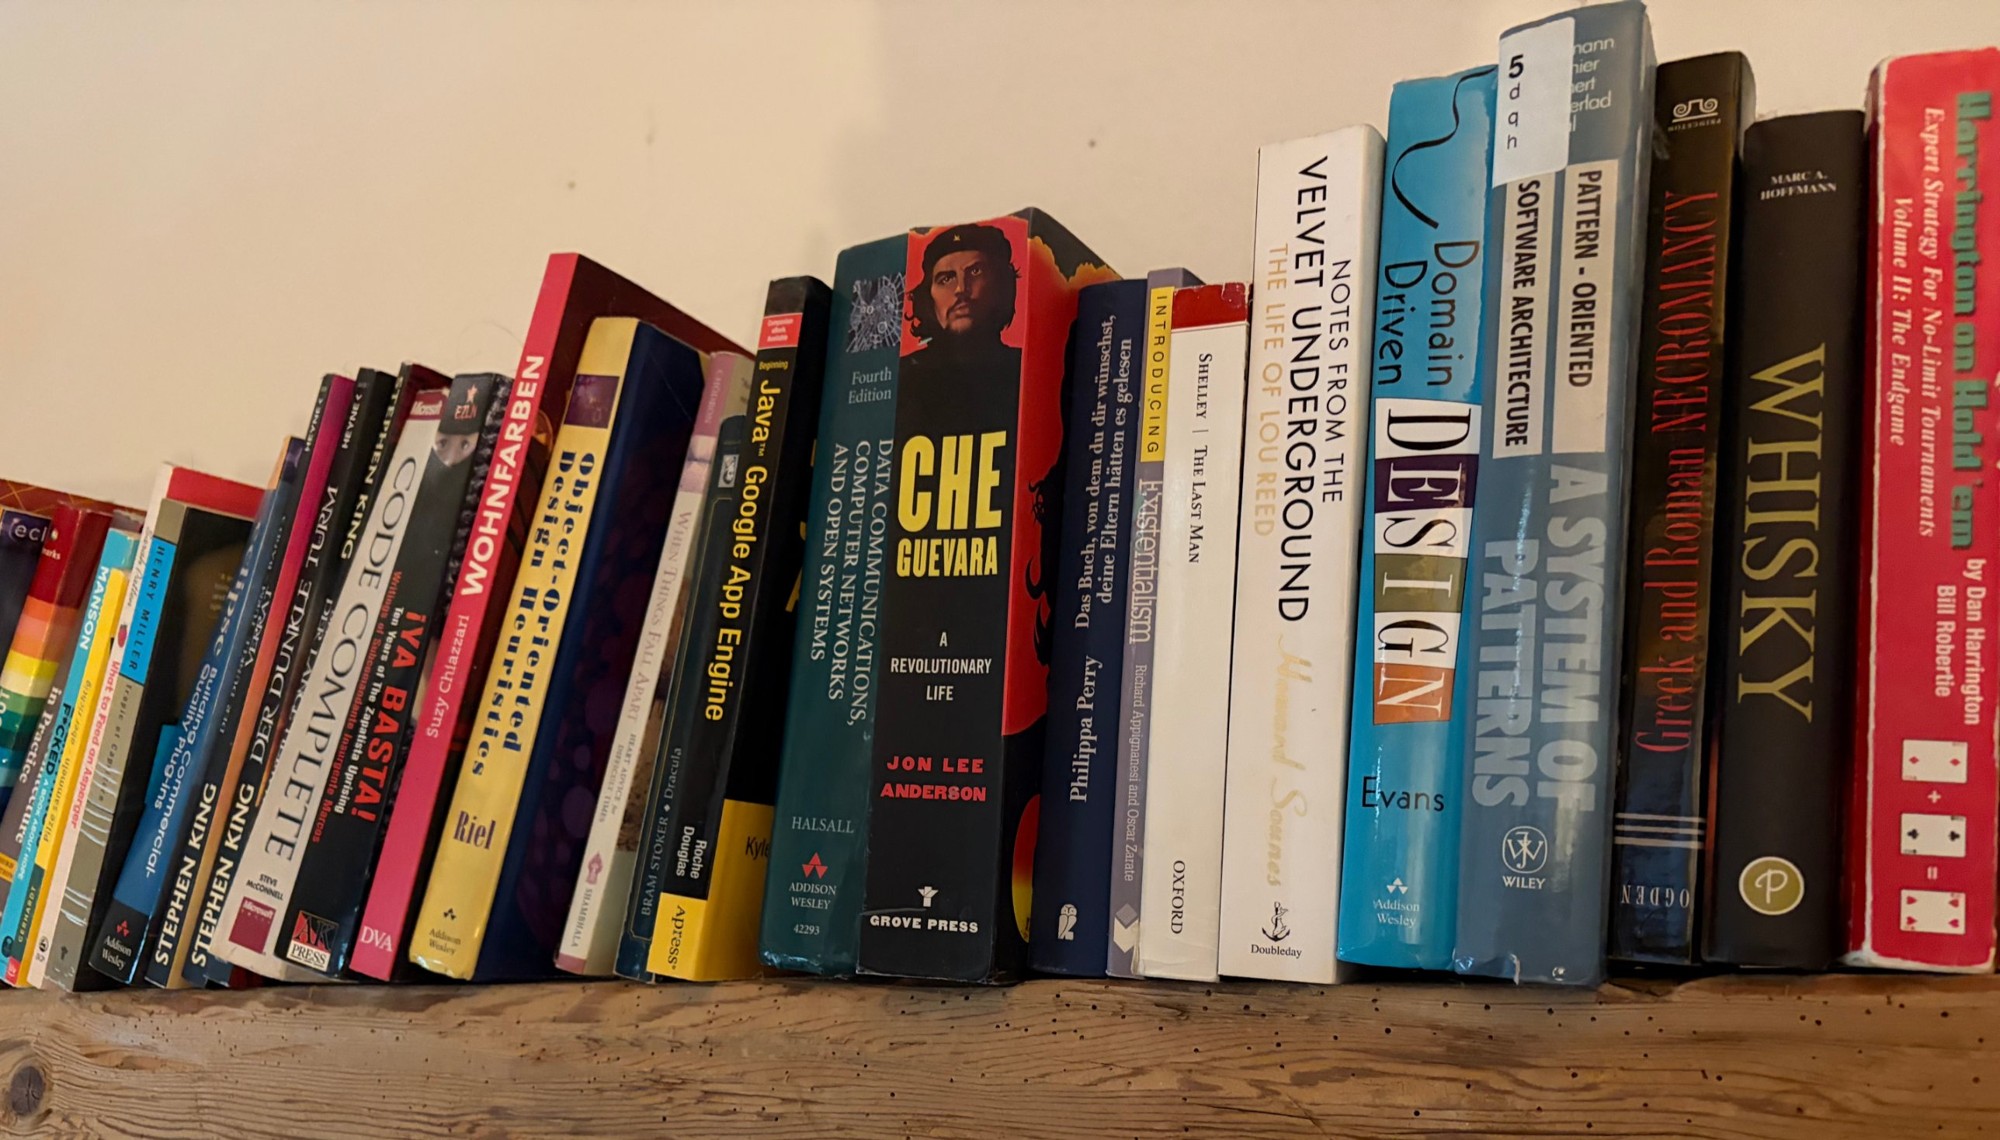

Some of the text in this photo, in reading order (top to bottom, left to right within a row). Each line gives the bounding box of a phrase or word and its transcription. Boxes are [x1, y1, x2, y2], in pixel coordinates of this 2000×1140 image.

[1508, 54, 1524, 79] 5
[1761, 181, 1837, 200] HOFFMANN
[1892, 196, 1914, 271] Volume
[1378, 260, 1428, 386] Driven
[1427, 241, 1480, 388] Domain
[1505, 179, 1540, 447] SOFTWARE ARCHITECTURE
[1891, 309, 1912, 347] The
[1917, 107, 1945, 537] Expert Strategy For No-Limit Tournaments
[847, 388, 892, 404] Edition
[851, 367, 893, 386] Fourth
[1146, 295, 1168, 454] INTRODUCING
[1254, 243, 1288, 537] THE LIFE OF LOU REED
[1278, 155, 1329, 622] VELVET UNDERGROUND
[1322, 260, 1351, 502] NOTES FROM THE
[1888, 352, 1912, 447] Endgame
[341, 377, 403, 561] STEPHEN KING
[460, 355, 545, 596] WOHNFARBEN
[897, 431, 1008, 533] CHE
[1189, 353, 1213, 564] SHELLEY THE LAST MAN
[1635, 190, 1719, 753] Greek and Roman NECROMANCY
[358, 456, 416, 590] CODE
[732, 465, 768, 560] Google
[811, 443, 850, 661] AND OPEN SYSTEMS
[896, 535, 998, 578] GUEVARA
[1738, 342, 1825, 723] WHISKY
[79, 566, 110, 650] MANSON
[128, 545, 166, 671] HENRY MILLER
[213, 521, 261, 656] eclipse
[503, 453, 595, 753] Object-Oriented
[718, 566, 751, 619] App
[828, 440, 871, 700] COMPUTER NETWORKS
[846, 438, 894, 727] DATA COMMUNICATIONS,
[1376, 408, 1472, 719] DESIGN
[250, 706, 276, 765] DER
[269, 579, 313, 699] DUNKLE
[305, 486, 339, 569] TURM
[472, 451, 577, 777] Design Heuristics
[939, 631, 949, 648] A
[1536, 464, 1608, 811] A SYSTEM OF
[1935, 585, 1957, 698] Bill Robertie
[1964, 558, 1987, 726] by Dan Harrington
[48, 687, 62, 705] in
[312, 570, 403, 843] Writings of Subcomandante Insurgente Marcos
[334, 605, 404, 815] Ten Years of The Zapatista Uprising
[425, 614, 471, 738] Suzy Chiazzari
[705, 627, 742, 722] Engine
[890, 657, 992, 675] REVOLUTIONARY
[925, 685, 954, 701] LIFE
[1471, 540, 1539, 807] PATTERNS
[19, 712, 53, 783] Practice
[72, 661, 121, 829] What to Feed an Asperger
[146, 667, 218, 878] Building Commercial-
[155, 664, 210, 809] Quality Plug-ins
[264, 602, 369, 862] COMPLETE
[352, 685, 408, 823] BASTA!
[886, 756, 984, 774] JON LEE
[1069, 654, 1104, 803] Philippa Perry
[1124, 664, 1148, 882] Richard Appignanesi and Oscar Zarate
[36, 790, 47, 817] BOOK
[43, 779, 49, 787] A
[791, 815, 855, 835] HALSALL
[880, 783, 987, 802] ANDERSON
[1362, 775, 1445, 812] Evans
[18, 853, 29, 880] HOPE
[26, 818, 39, 852] ABOUT
[154, 782, 217, 967] STEPHEN KING
[190, 783, 255, 967] STEPHEN KING
[452, 811, 497, 851] Riel
[641, 747, 683, 916] BRAM STOKER Dracula
[676, 826, 695, 877] Douglas
[690, 839, 708, 880] Roche
[18, 887, 36, 943] GERHARDT
[242, 900, 274, 919] Microsoft
[246, 879, 284, 901] McCONNELL
[259, 873, 278, 887] STEVE
[570, 887, 592, 947] SHAMBHALA
[788, 881, 837, 896] ADDISON
[790, 895, 832, 911] WESLEY
[869, 915, 979, 933] GROVE PRESS
[1170, 860, 1186, 935] OXFORD
[1375, 899, 1420, 912] Addison
[1377, 913, 1416, 928] Wesley
[1502, 876, 1546, 890] WILEY
[1620, 884, 1690, 908] OGDEN
[102, 948, 126, 970] Wesley
[104, 936, 131, 956] Addison
[292, 943, 327, 965] PRESS
[360, 924, 393, 952] DVA
[793, 923, 820, 936] 42293
[1250, 944, 1302, 960] Doubleday
